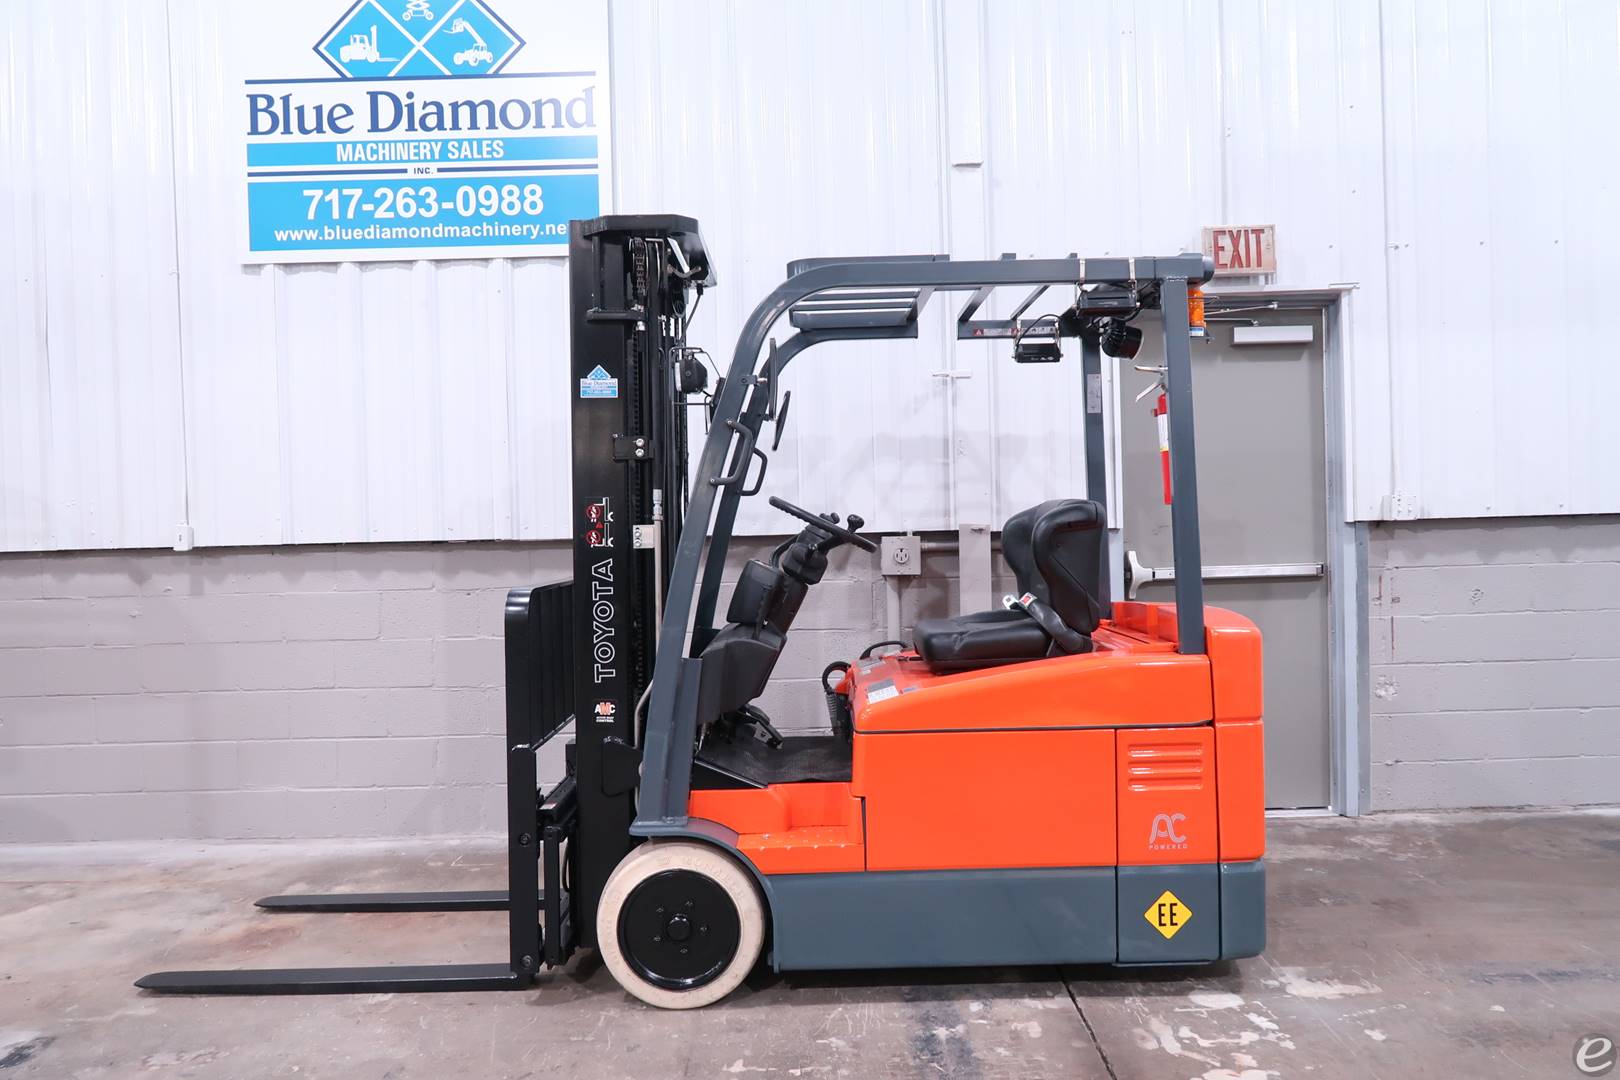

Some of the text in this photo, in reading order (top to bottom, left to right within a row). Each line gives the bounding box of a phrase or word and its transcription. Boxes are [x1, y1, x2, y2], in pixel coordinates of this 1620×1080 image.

[246, 86, 596, 136] Blue Diamond
[336, 140, 505, 162] MACHINERY SALES
[413, 167, 434, 175] INC.
[303, 184, 544, 219] 717-263-0988
[274, 223, 569, 242] www.bluediamondmachinery.ne
[1213, 229, 1264, 269] EXIT
[592, 558, 616, 683] TOYOTA
[1149, 813, 1186, 844] AC
[1158, 903, 1178, 926] EE
